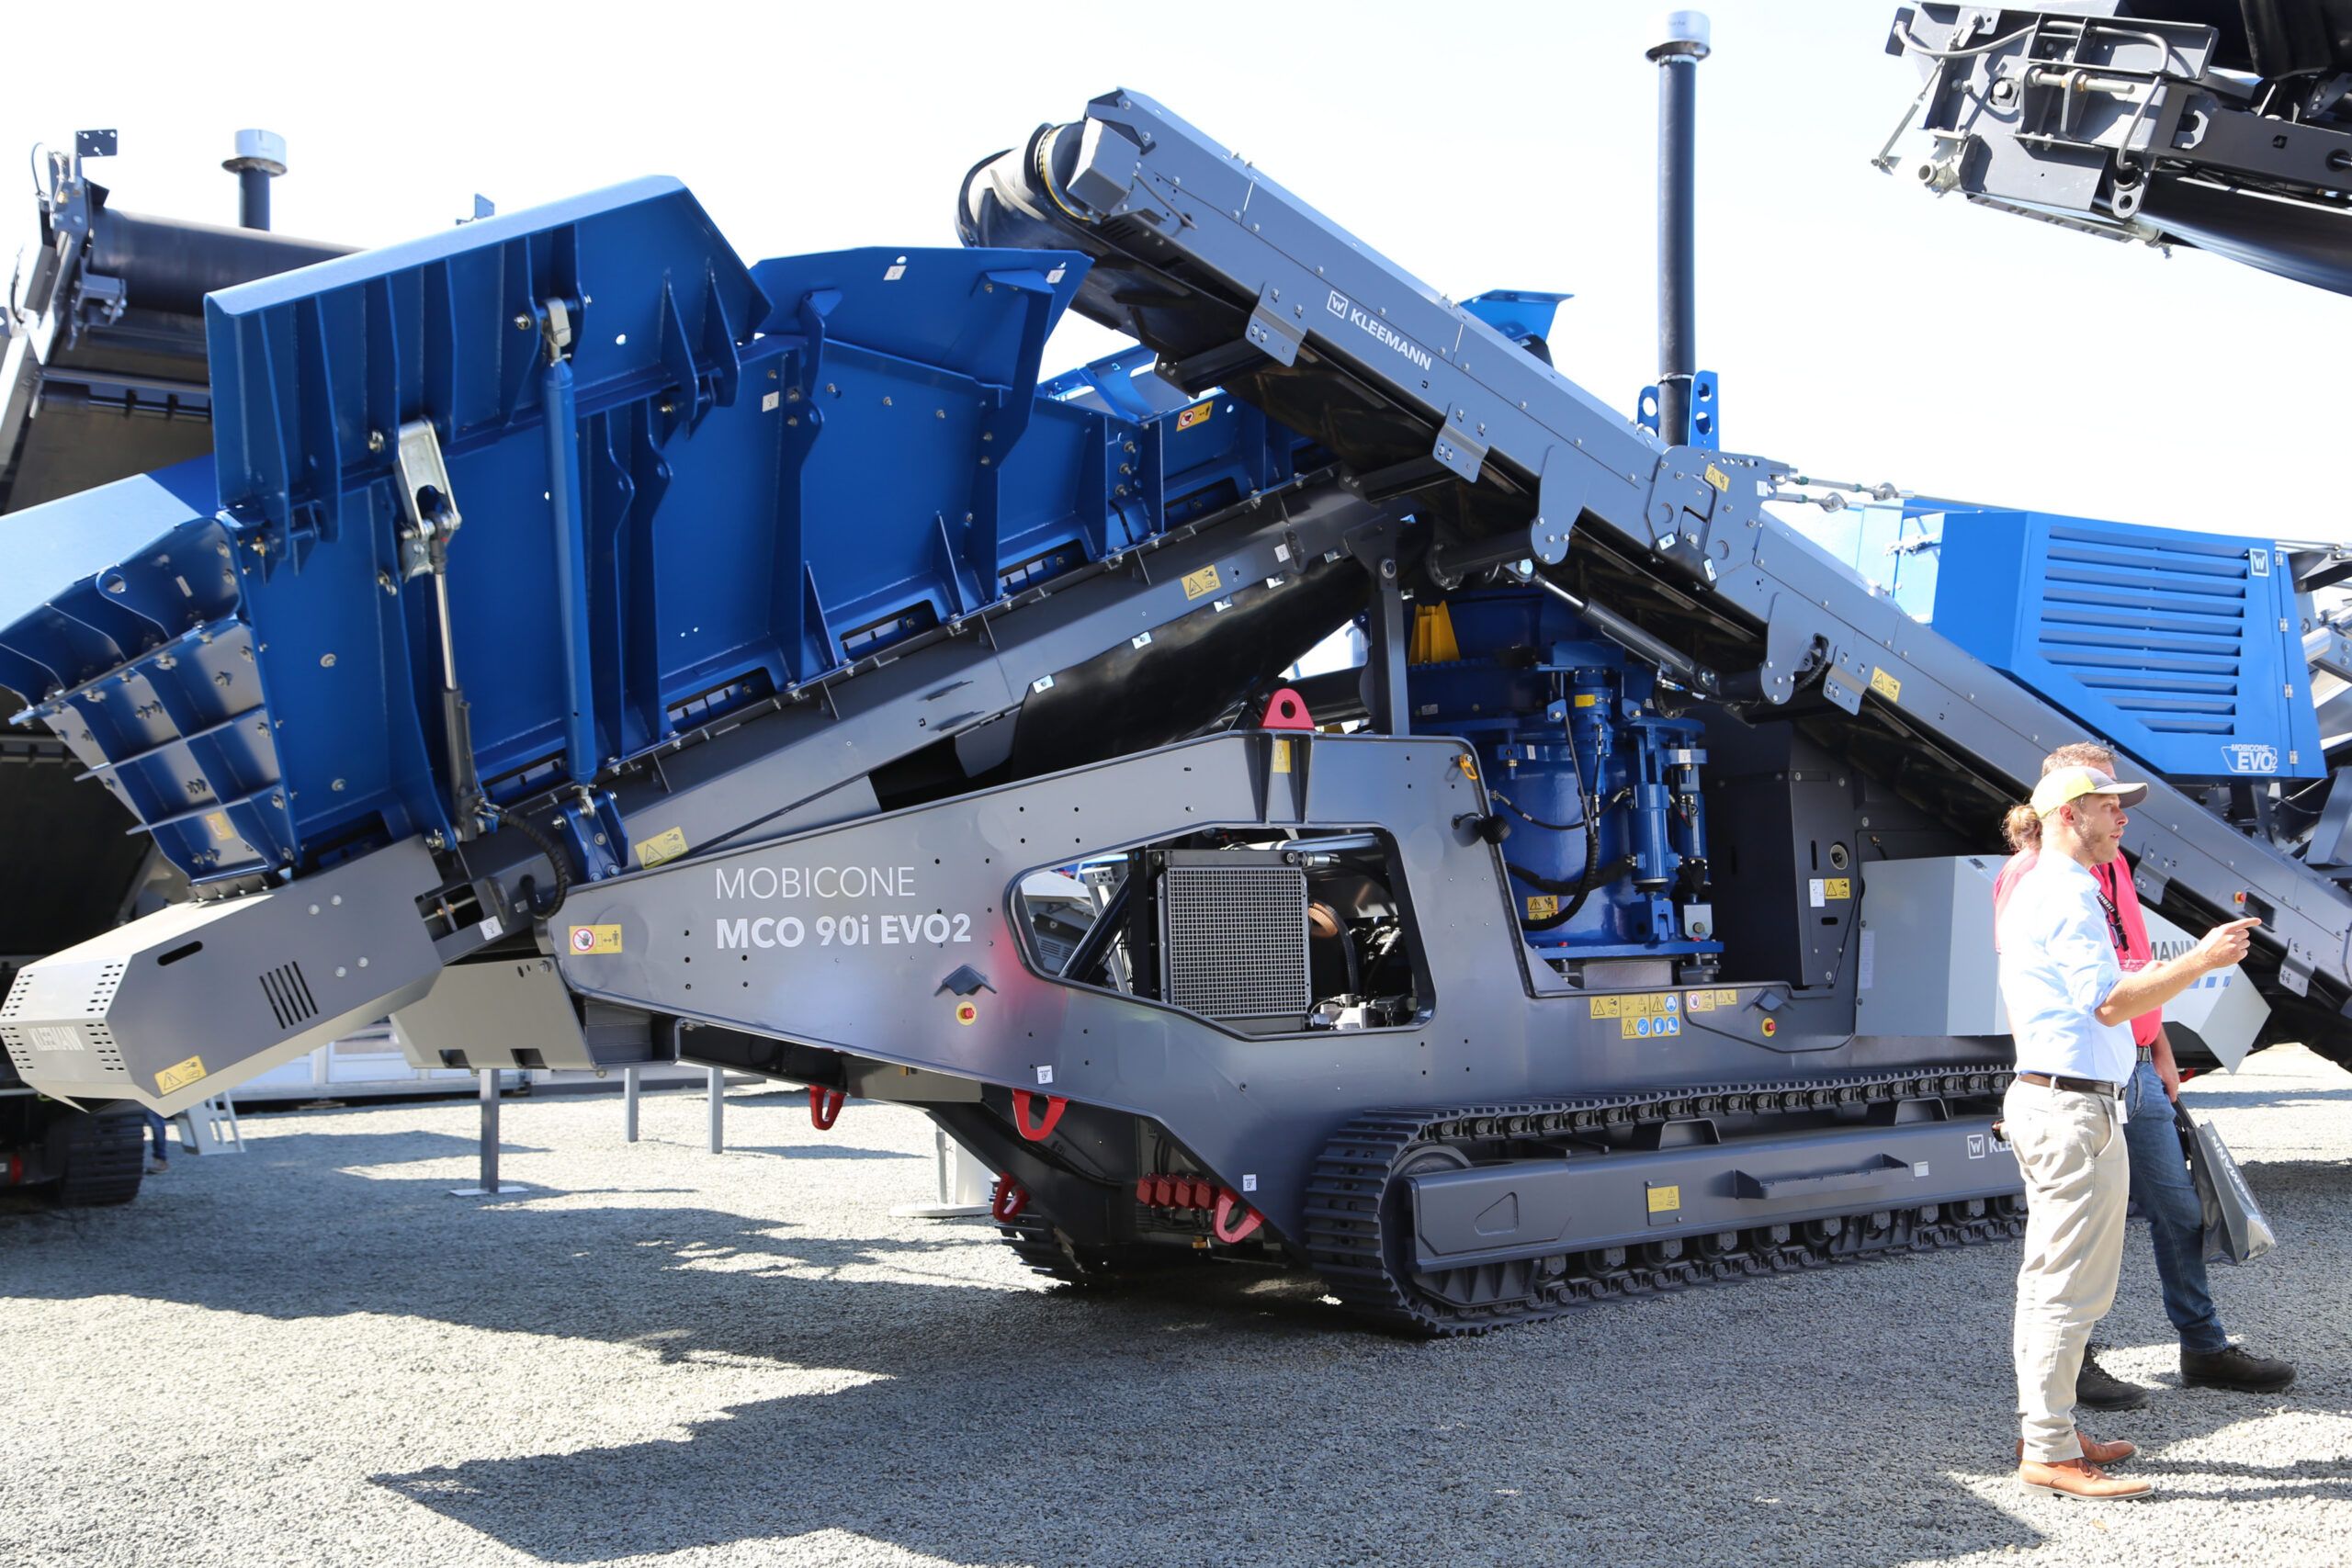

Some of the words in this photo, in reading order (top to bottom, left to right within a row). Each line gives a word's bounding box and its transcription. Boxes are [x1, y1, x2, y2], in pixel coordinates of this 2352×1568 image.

[1350, 308, 1432, 371] KLEEMANN
[2231, 744, 2269, 752] MOBICONE
[716, 866, 916, 899] MOBICONE
[717, 916, 806, 950] MCO
[815, 914, 871, 947] 90i
[880, 913, 972, 945] EVO2
